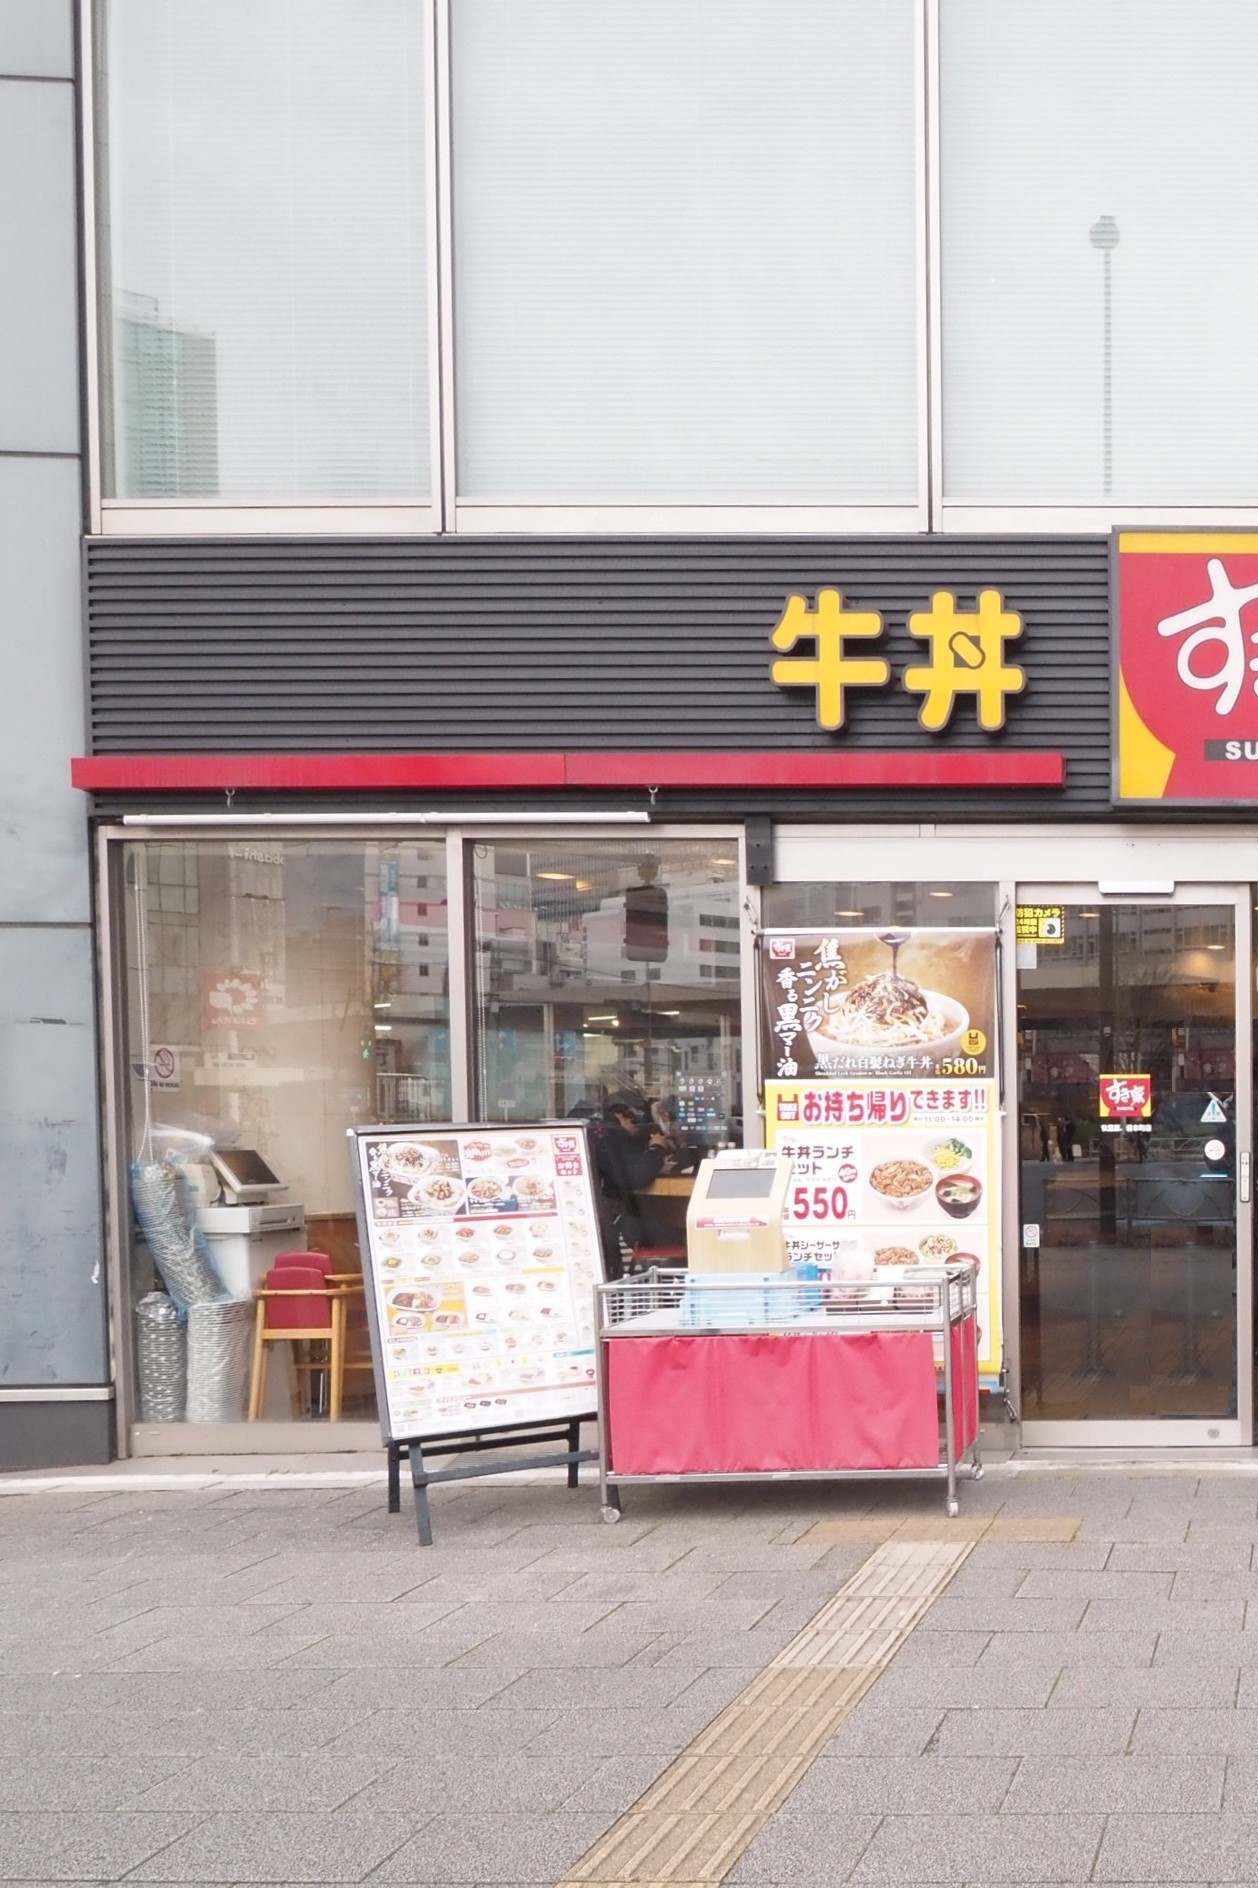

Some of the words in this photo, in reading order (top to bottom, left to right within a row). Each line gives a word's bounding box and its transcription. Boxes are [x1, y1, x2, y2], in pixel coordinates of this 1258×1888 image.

[769, 586, 1026, 733] 牛丼
[797, 961, 824, 1033] ニンニク
[814, 937, 848, 1014] 焦がし
[774, 966, 803, 1077] 香る黒マー油
[781, 1145, 854, 1159] 牛丼ランチ
[791, 1161, 822, 1175] ット
